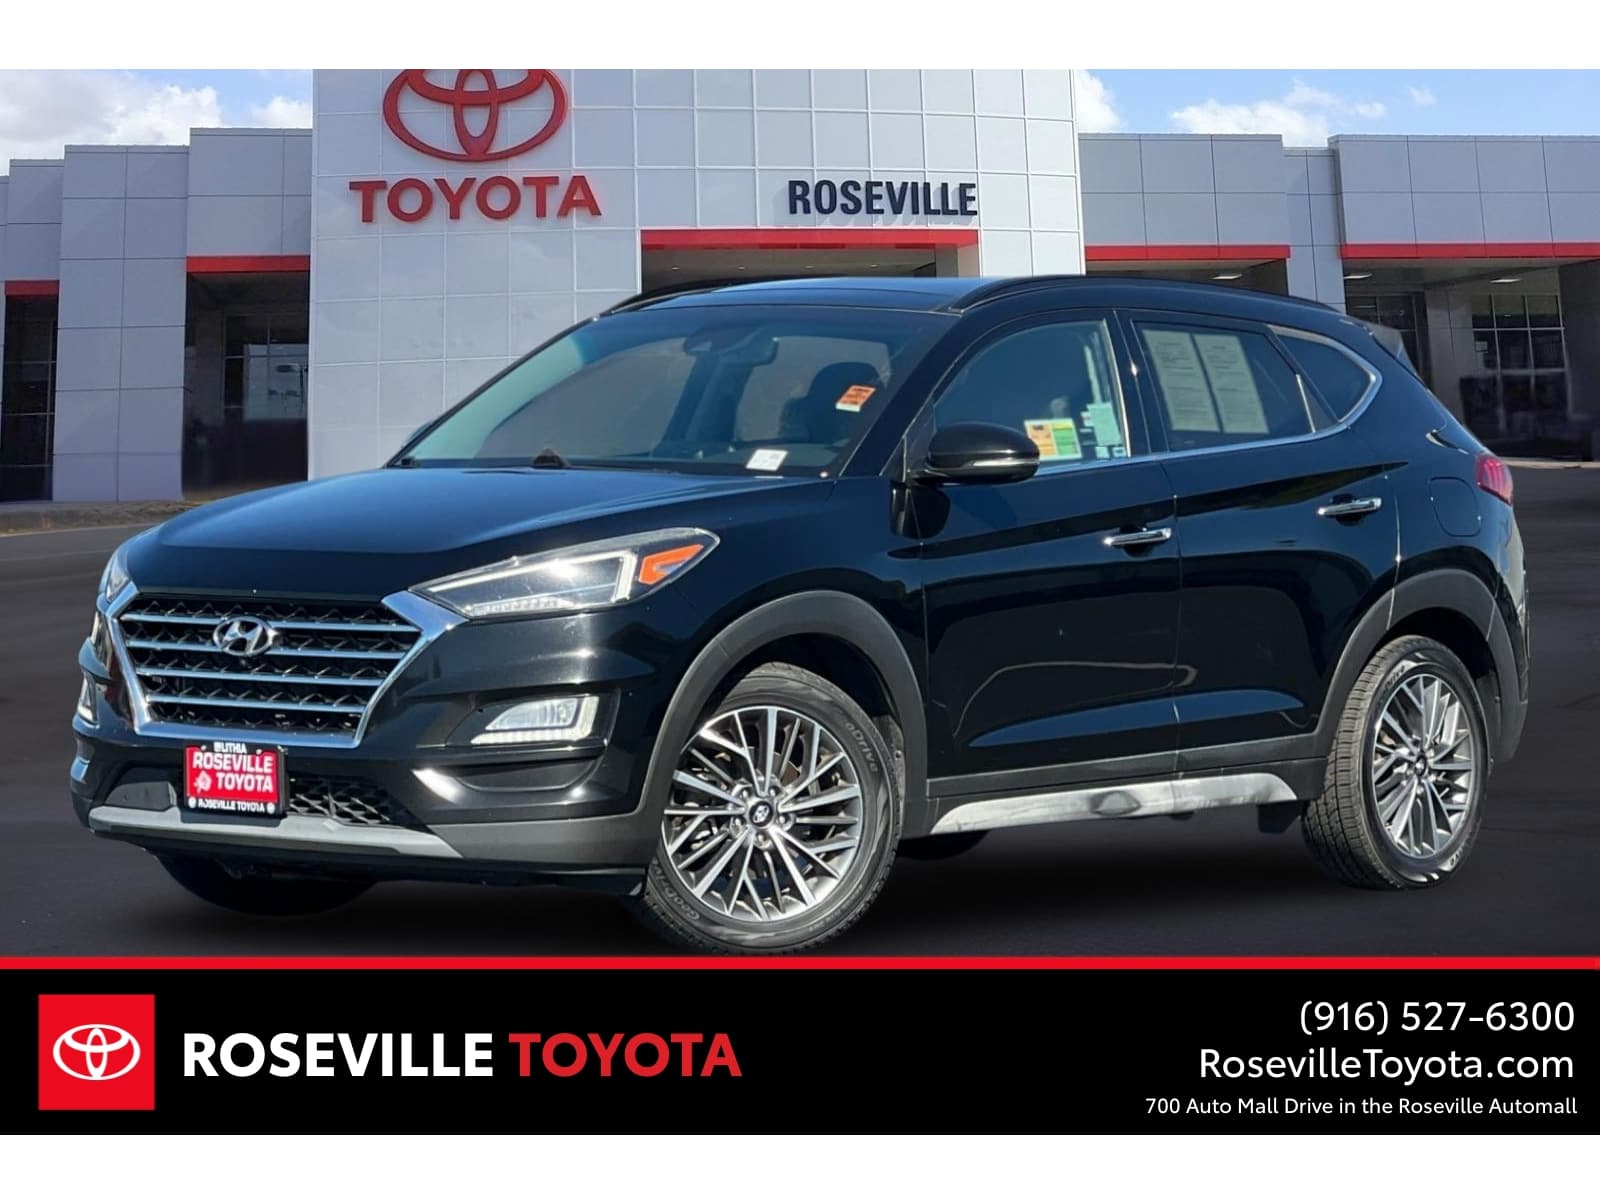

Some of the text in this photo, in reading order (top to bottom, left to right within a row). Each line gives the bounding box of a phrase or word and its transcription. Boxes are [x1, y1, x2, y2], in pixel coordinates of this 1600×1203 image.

[349, 175, 602, 222] TOYOTA
[788, 180, 978, 216] ROSEVILLE
[193, 751, 273, 774] ROSEVILLE
[216, 772, 273, 793] TOYOTA
[237, 801, 265, 813] TOYOTA
